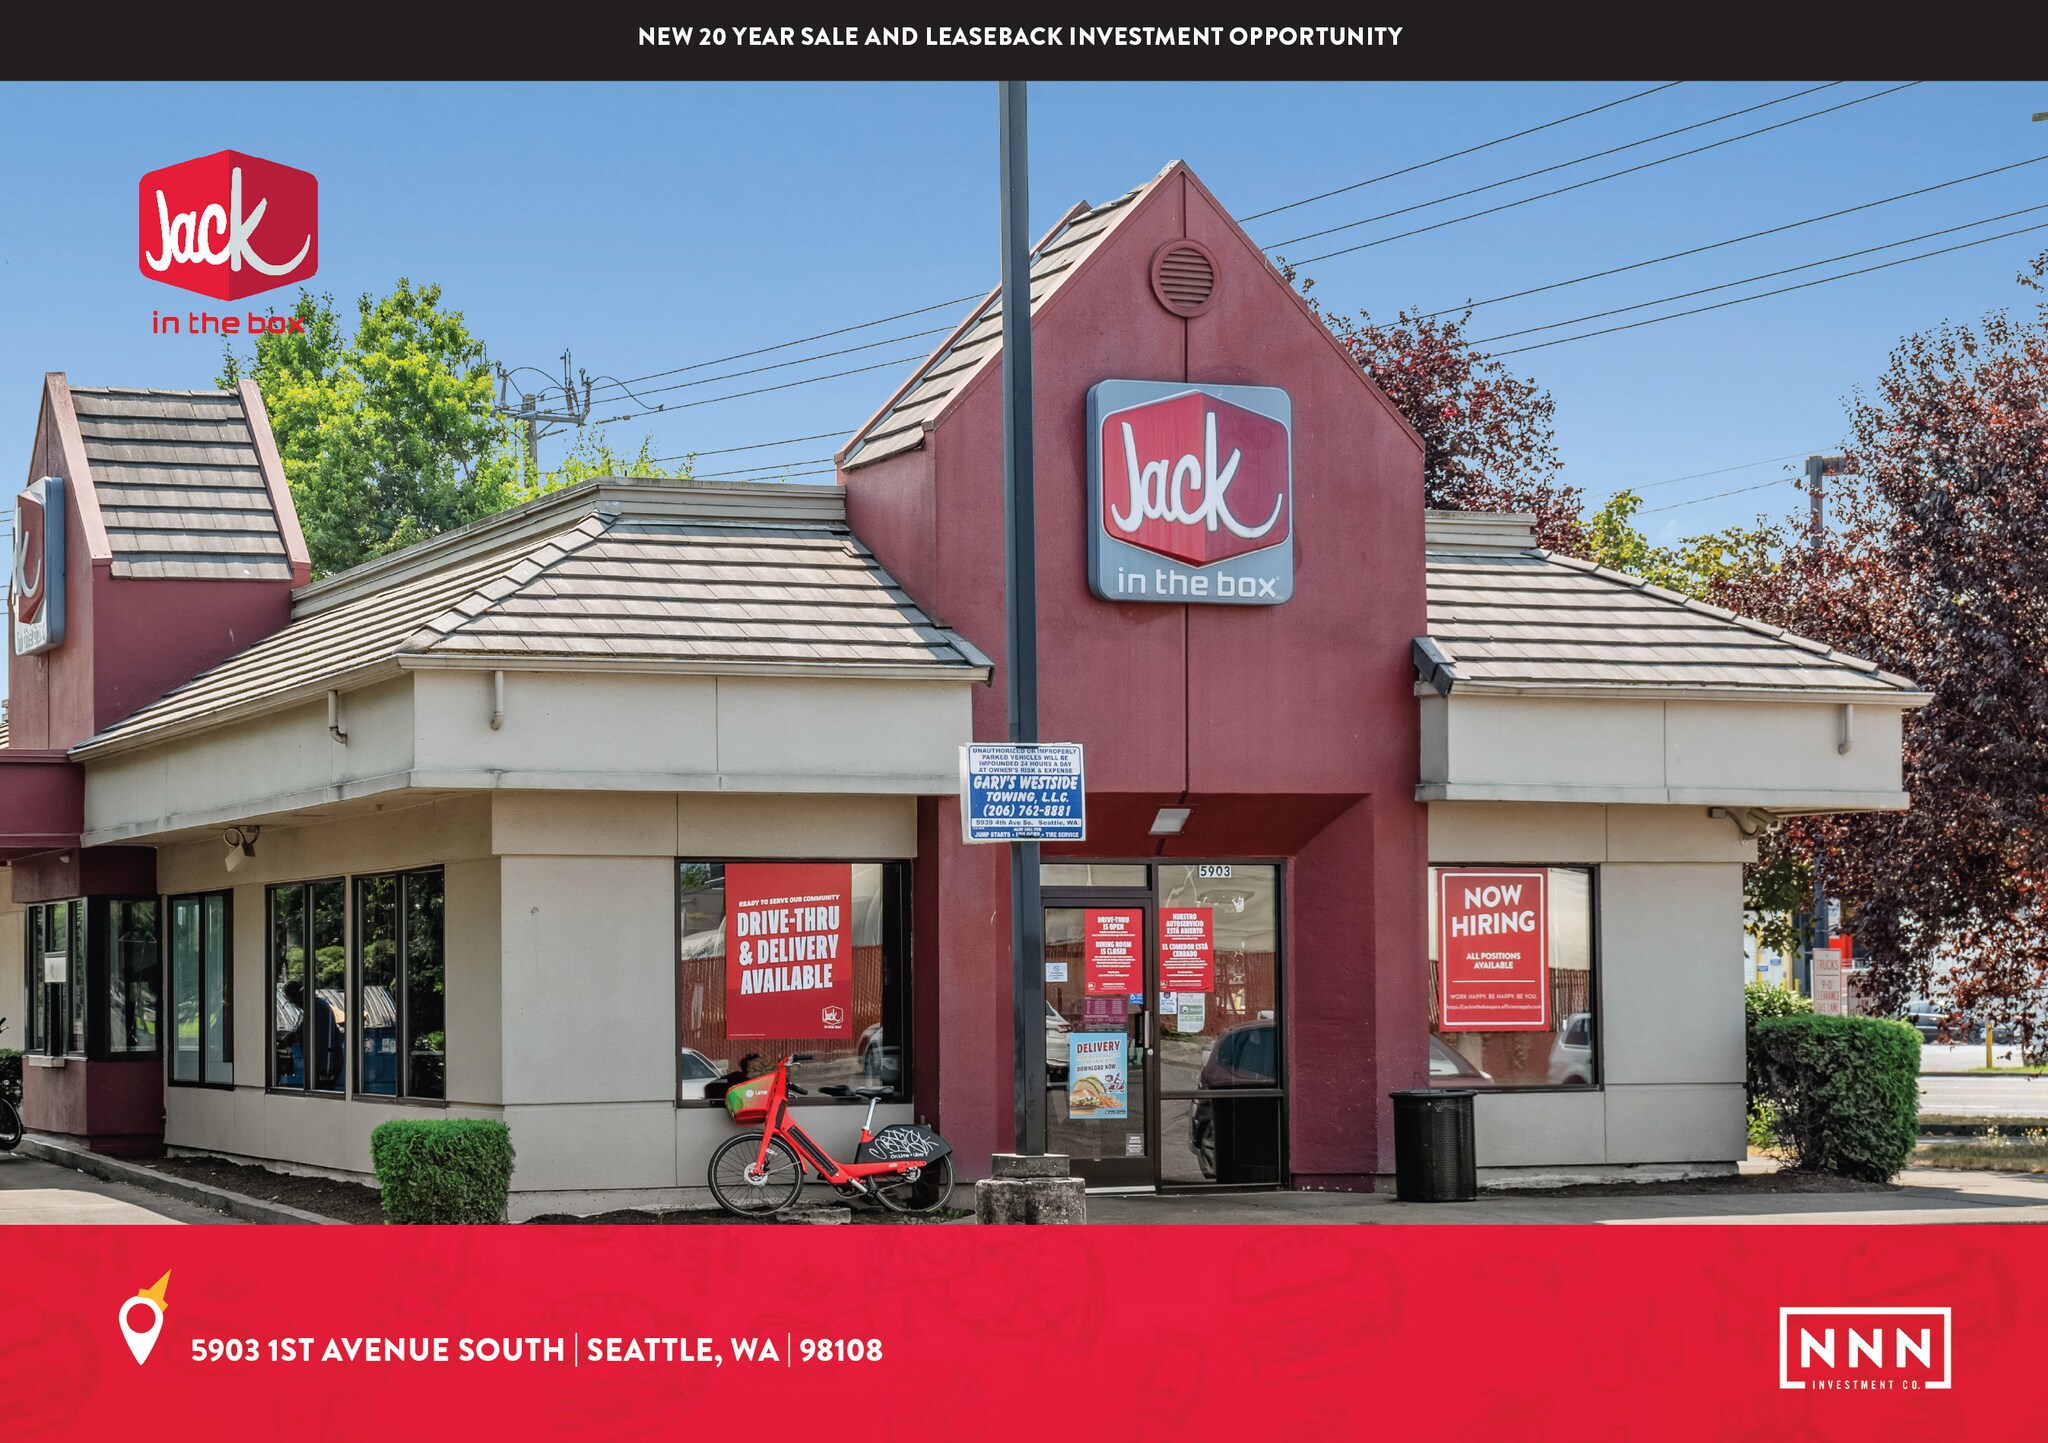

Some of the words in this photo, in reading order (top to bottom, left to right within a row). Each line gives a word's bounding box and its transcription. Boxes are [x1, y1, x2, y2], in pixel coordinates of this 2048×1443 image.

[1111, 411, 1283, 539] Jack
[1118, 566, 1146, 594] in
[1156, 568, 1209, 596] the
[1217, 571, 1276, 598] box
[974, 775, 1017, 790] GARY'S
[1020, 776, 1078, 790] WESTSIDE
[986, 792, 1037, 804] TOWING,
[1042, 792, 1069, 802] L.L.C.
[983, 804, 1015, 817] (206)
[1018, 805, 1071, 817] 762-8881
[1200, 865, 1231, 877] 5903
[803, 894, 840, 902] COMMUNITY
[1464, 884, 1523, 910] NOW
[737, 905, 840, 937] DRIVE-THRU
[1097, 916, 1130, 924] DRIVE-THRU
[1166, 920, 1204, 928] AUTOSERVICIO
[1452, 910, 1535, 938] HIRING
[739, 941, 753, 966] &
[757, 934, 839, 965] DELIVERY
[1466, 952, 1480, 960] ALL
[1481, 952, 1521, 960] POSITIONS
[1473, 961, 1514, 970] AVAILABLE
[1816, 959, 1839, 970] TRUCKS
[741, 963, 833, 995] AVAILABLE
[1076, 1041, 1120, 1053] DELIVERY
